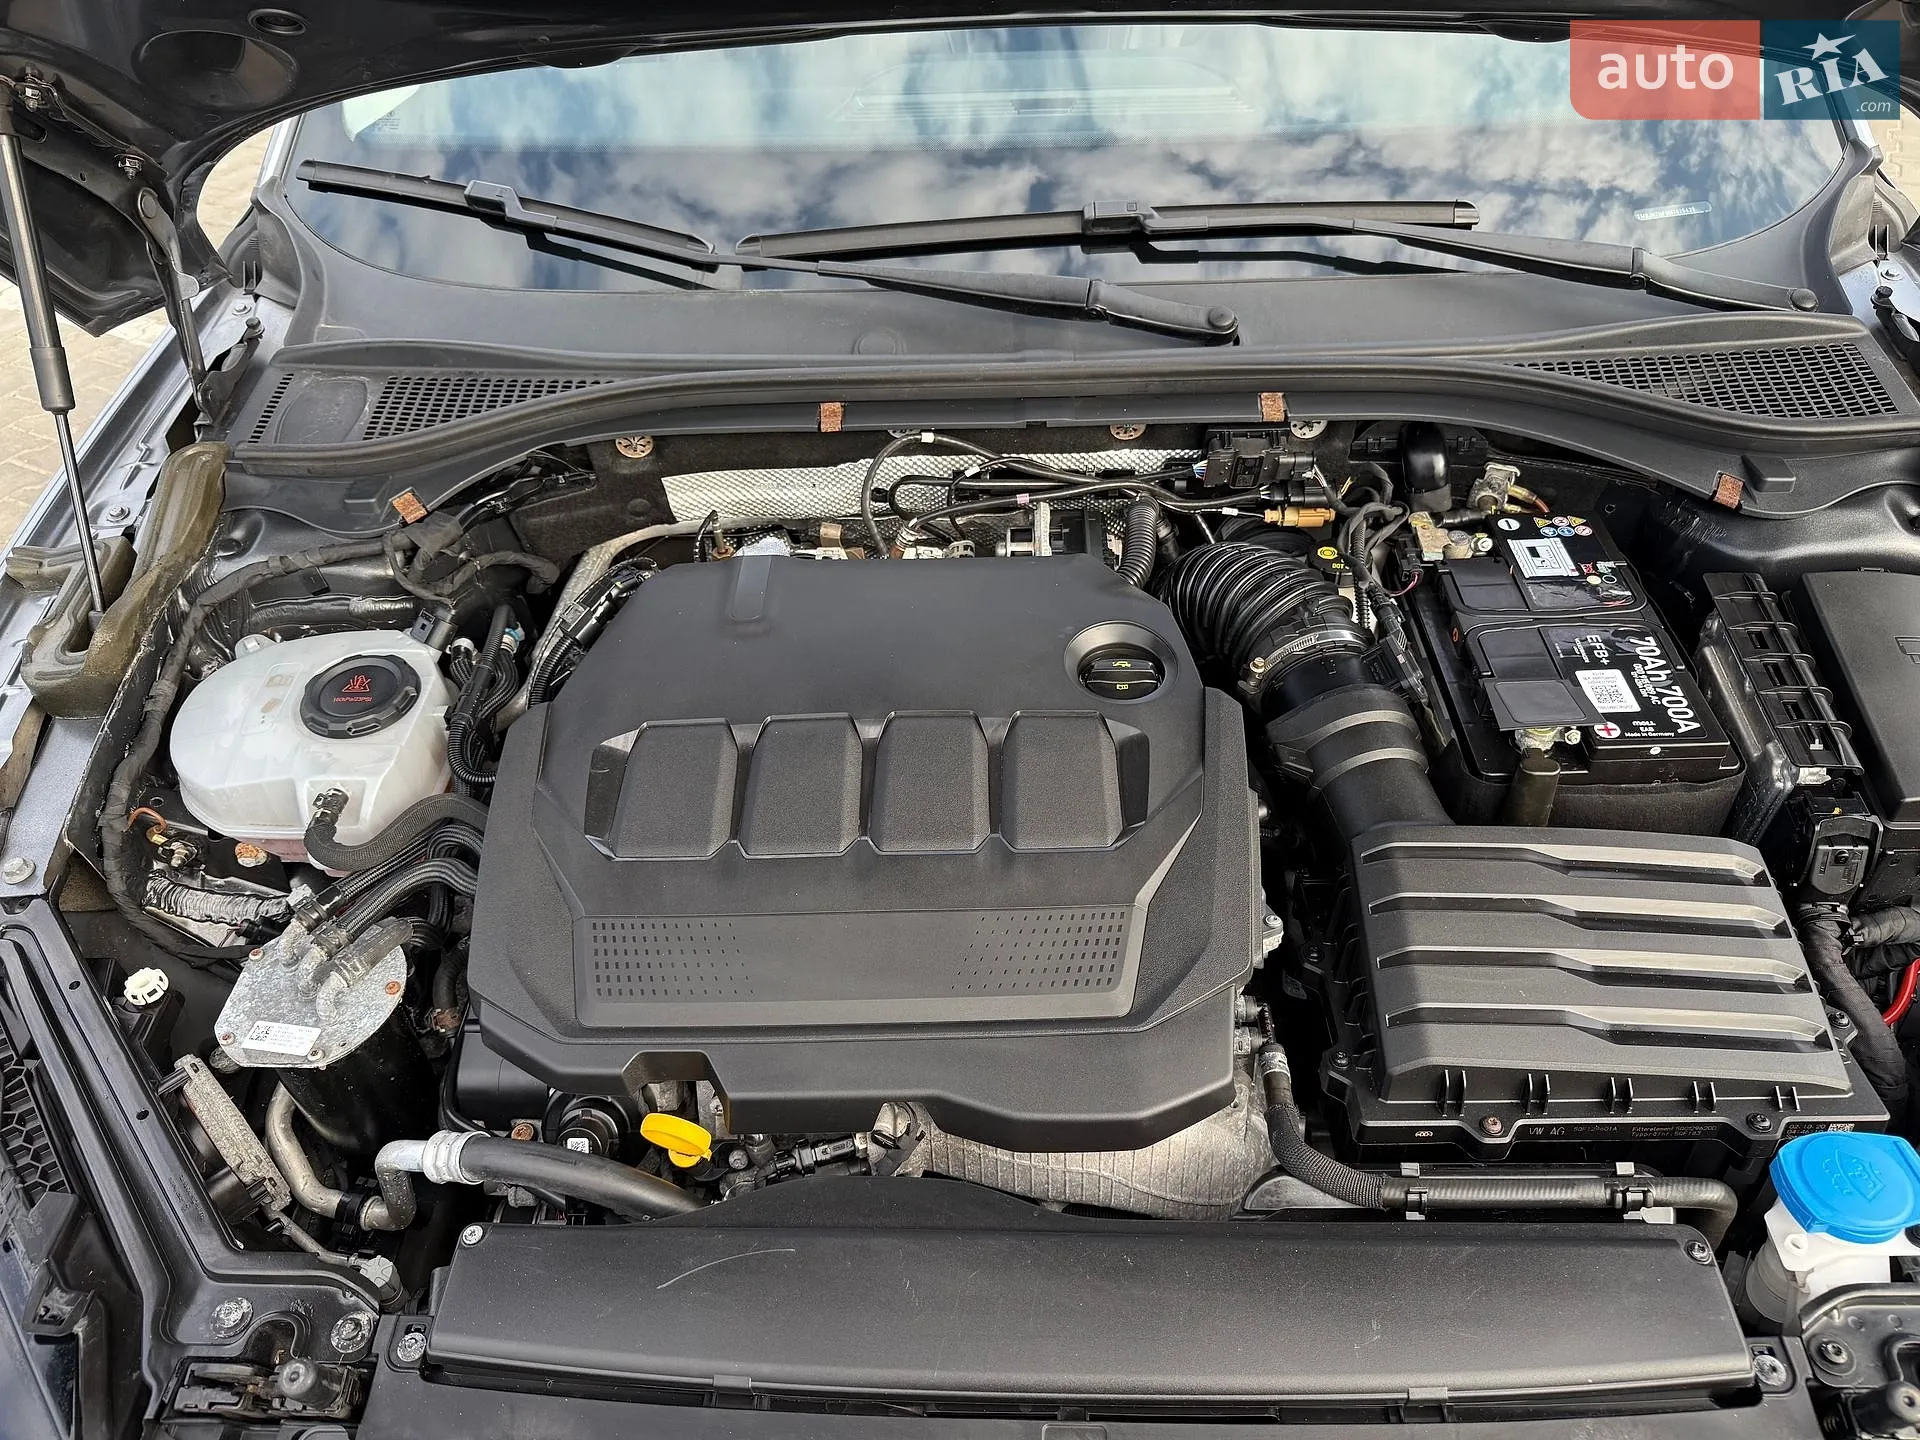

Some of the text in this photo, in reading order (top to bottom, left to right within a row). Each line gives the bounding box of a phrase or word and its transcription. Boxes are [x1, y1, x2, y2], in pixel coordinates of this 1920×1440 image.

[1586, 634, 1610, 666] EFB+
[1655, 685, 1701, 734] 700A
[1529, 1126, 1566, 1136] VW AG
